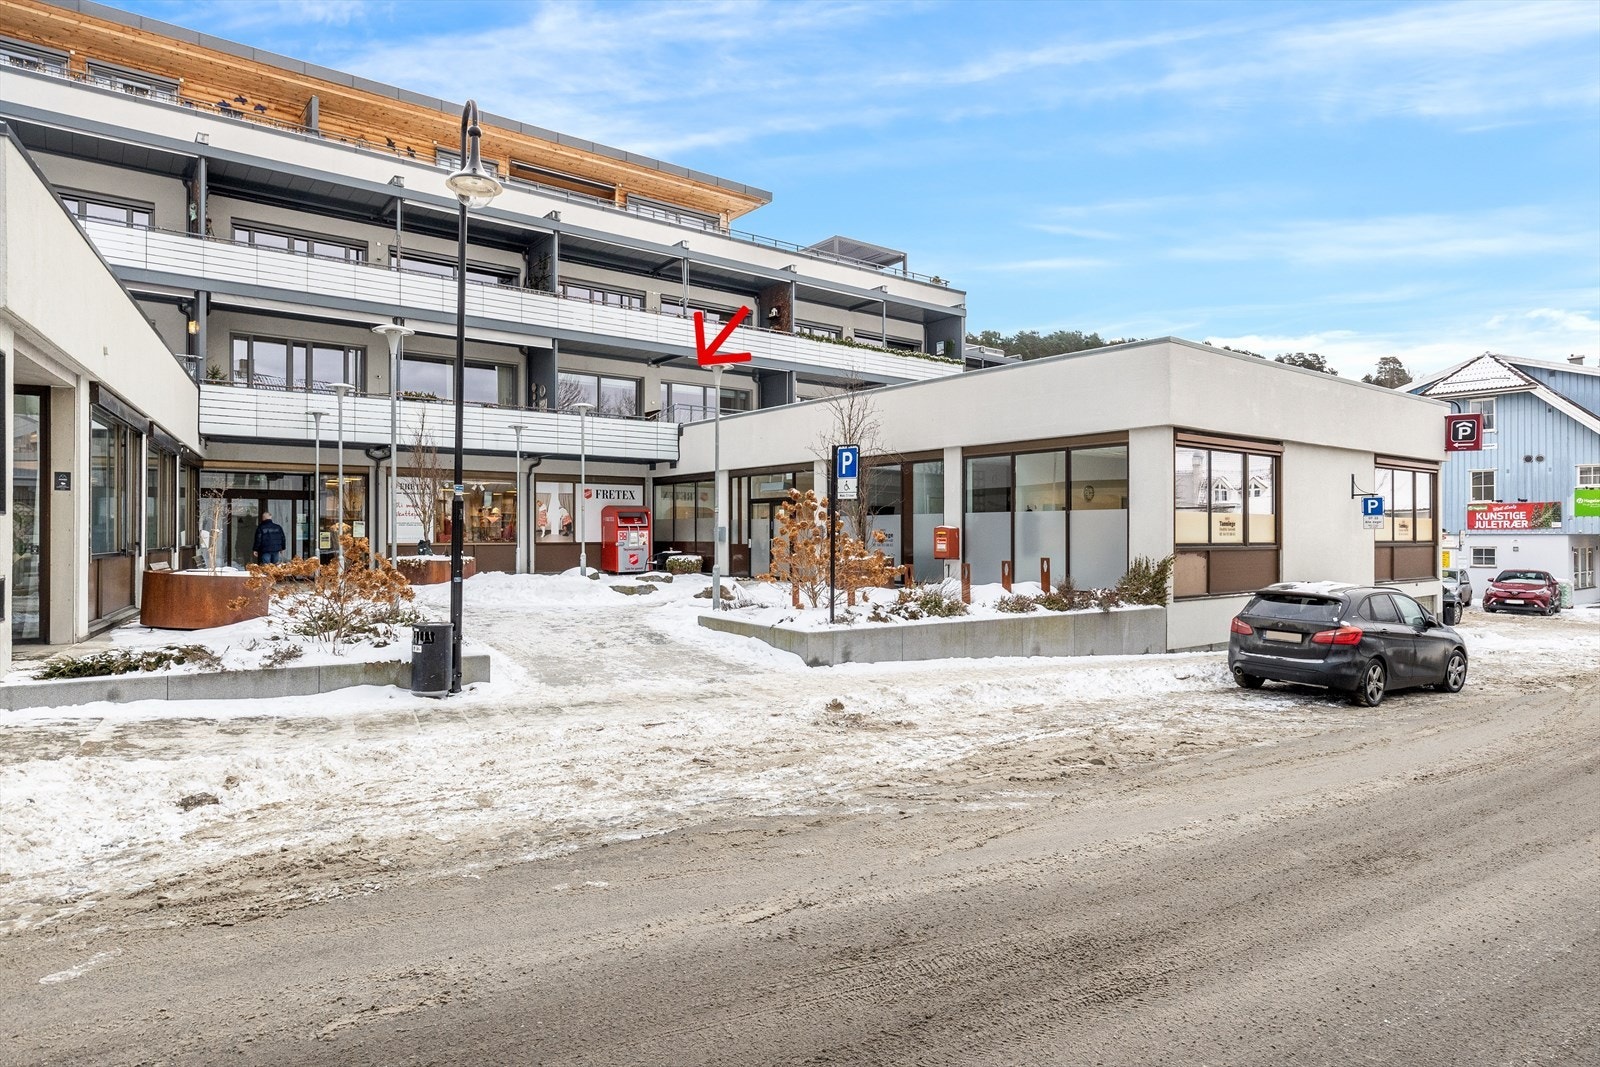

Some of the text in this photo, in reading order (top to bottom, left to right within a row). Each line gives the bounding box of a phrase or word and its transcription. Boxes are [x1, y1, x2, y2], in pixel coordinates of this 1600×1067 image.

[1458, 427, 1471, 439] P
[842, 452, 853, 474] P
[595, 489, 636, 500] FRETEX
[1368, 500, 1379, 513] P
[1475, 511, 1527, 520] KUNSTIGE
[1474, 520, 1529, 529] JULETRÆR
